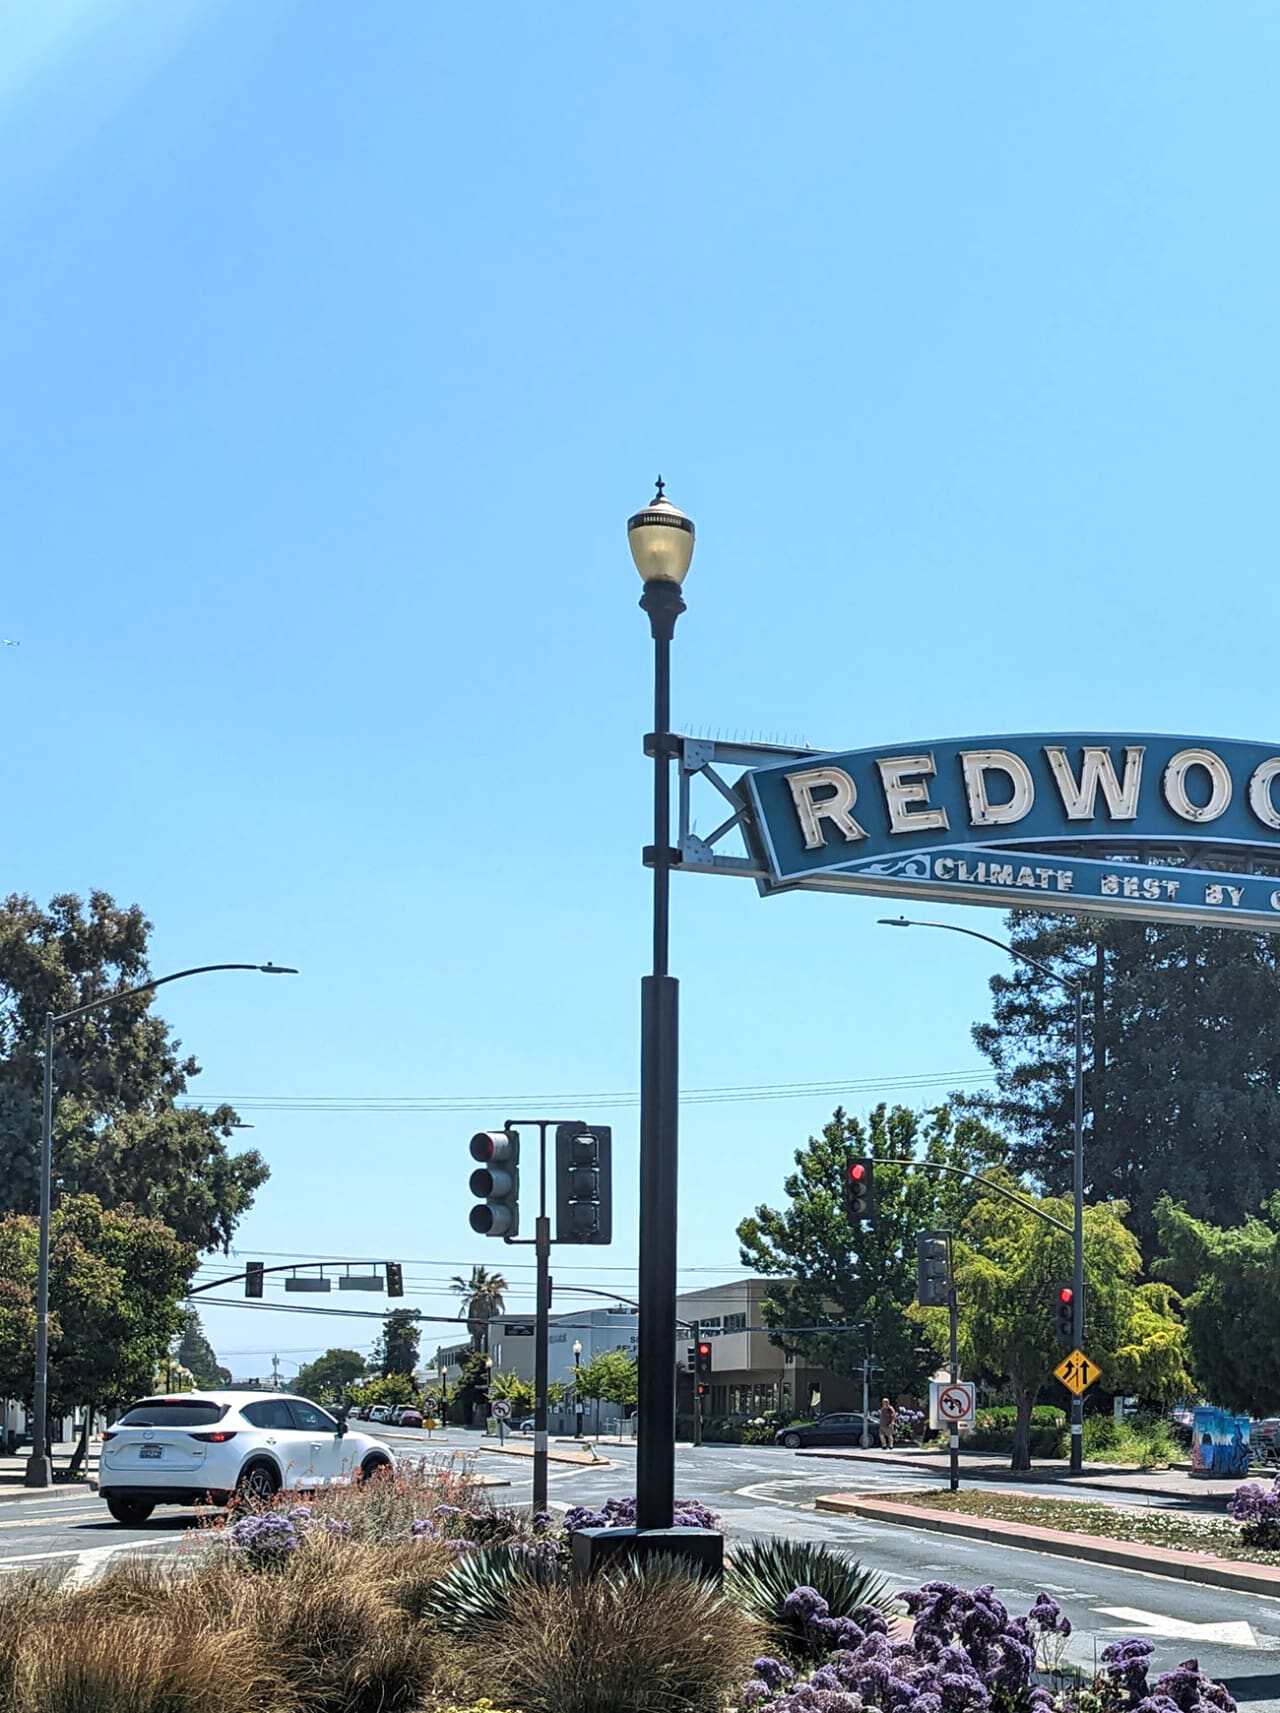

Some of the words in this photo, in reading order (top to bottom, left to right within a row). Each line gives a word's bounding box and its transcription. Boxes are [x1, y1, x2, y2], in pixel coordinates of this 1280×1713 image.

[934, 857, 1073, 891] CLIMATE
[1101, 874, 1180, 900] BEST
[1205, 883, 1245, 907] BY
